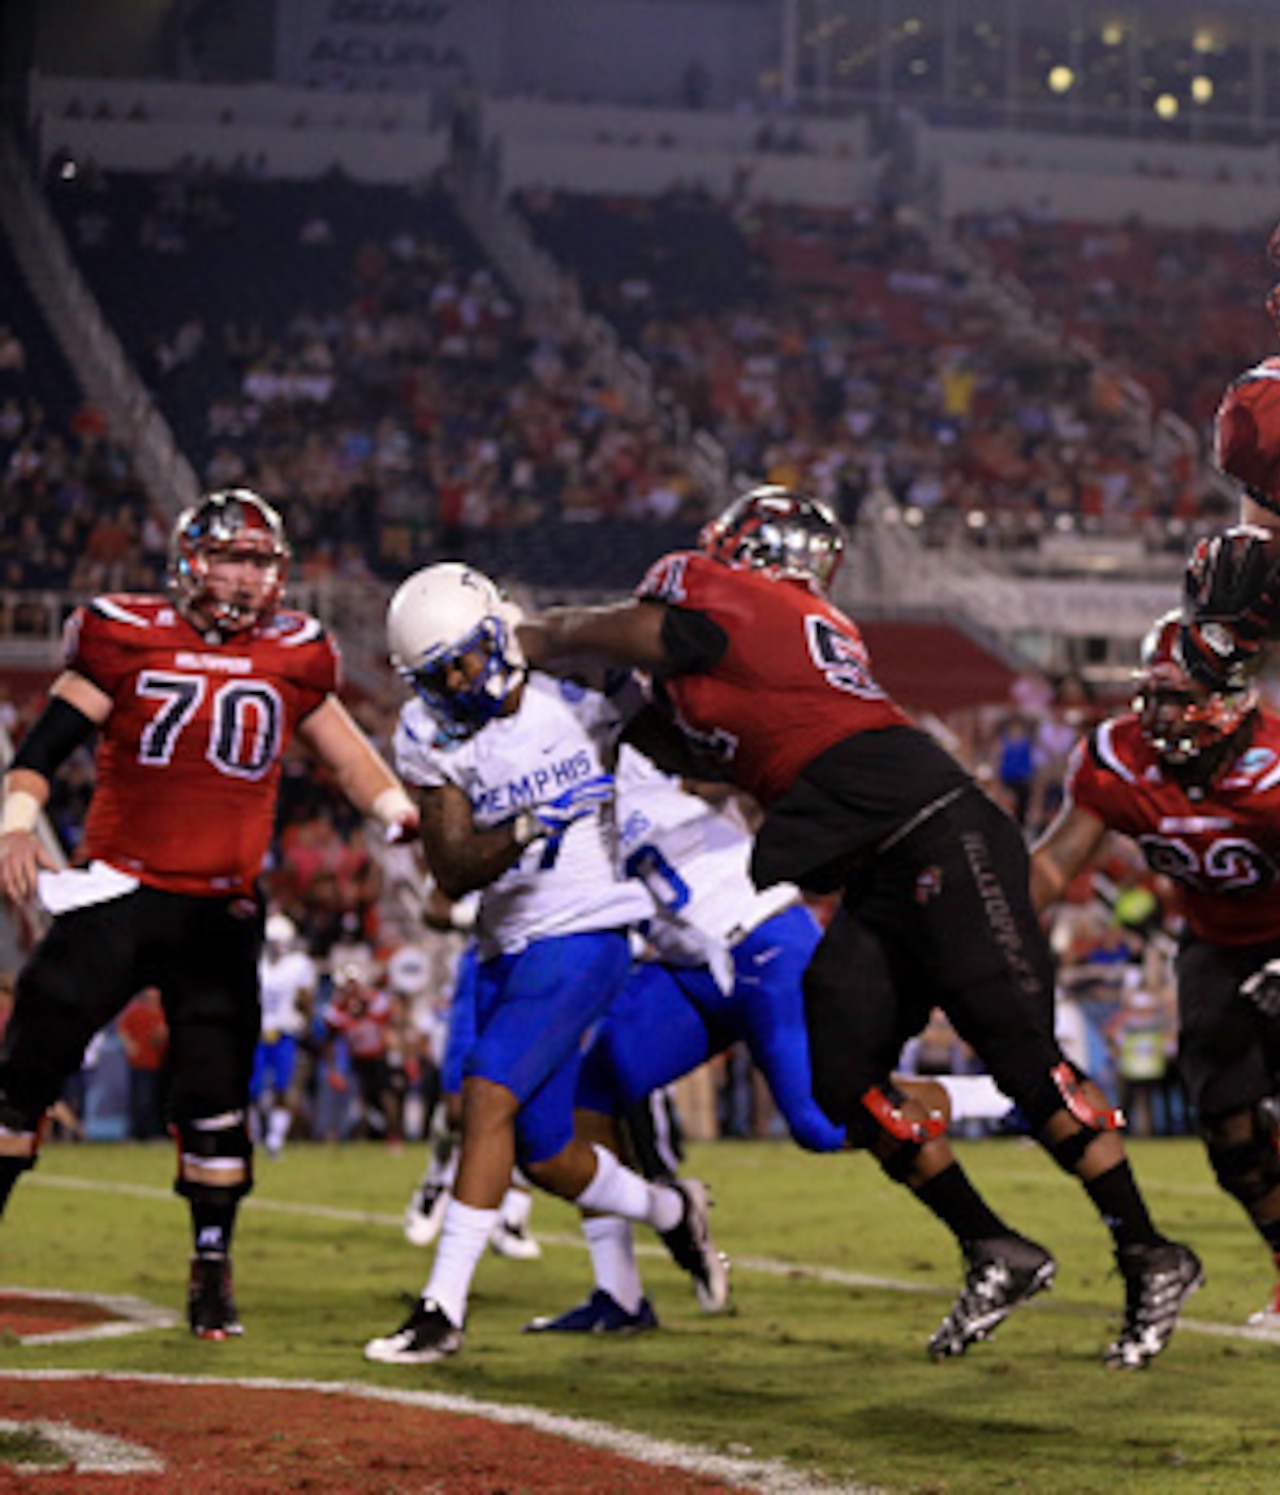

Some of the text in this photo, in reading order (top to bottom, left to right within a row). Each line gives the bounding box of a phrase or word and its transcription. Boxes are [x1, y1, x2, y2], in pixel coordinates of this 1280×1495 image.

[308, 37, 470, 69] ACURA
[136, 670, 284, 781] 70
[471, 750, 594, 815] MEMPHIS
